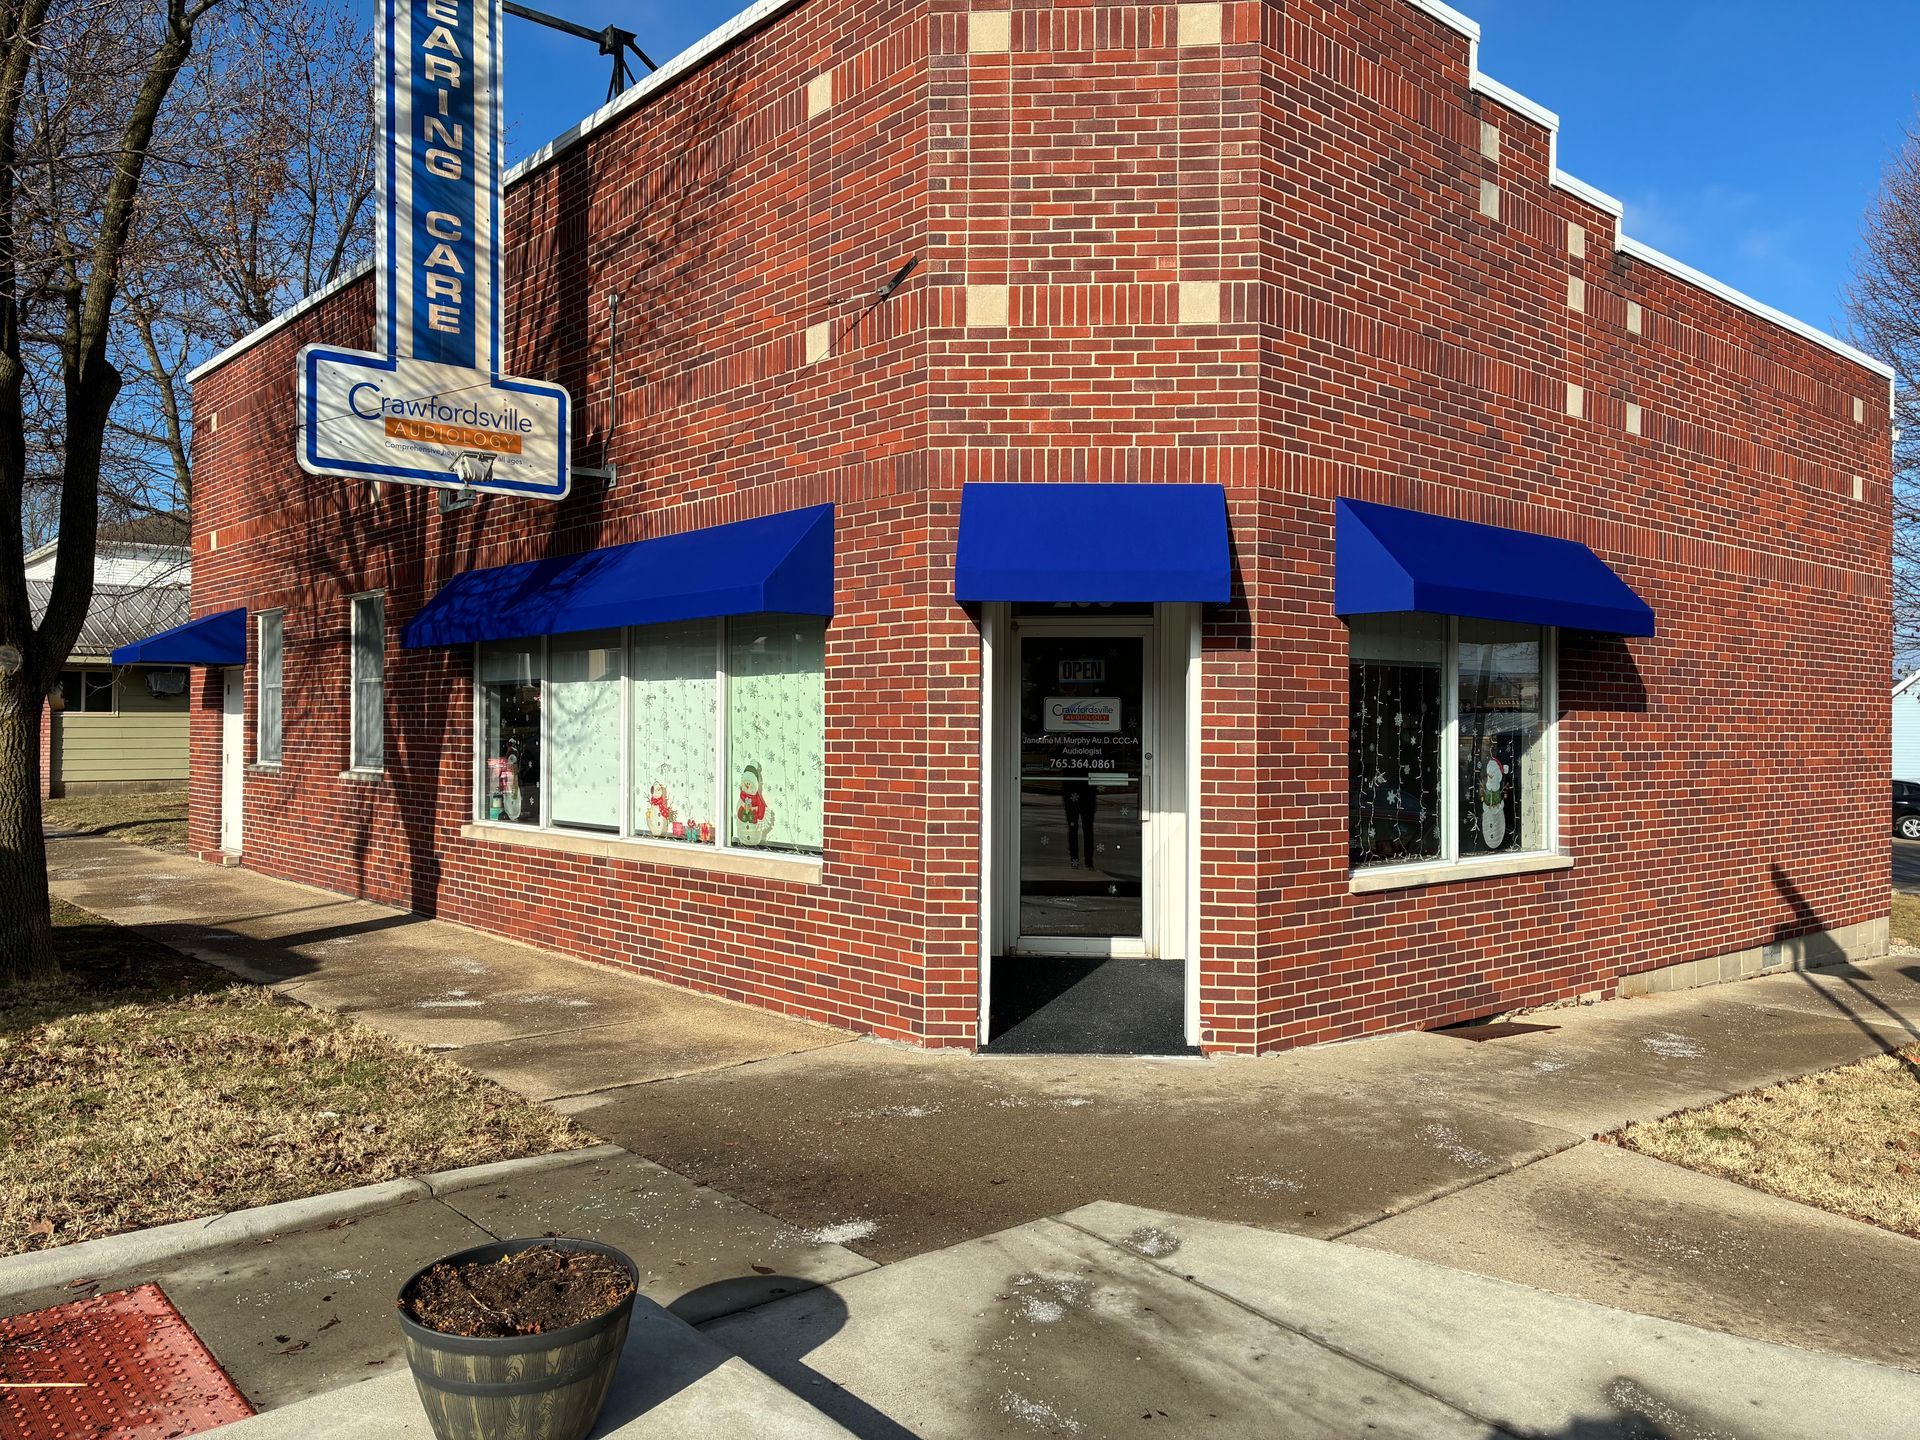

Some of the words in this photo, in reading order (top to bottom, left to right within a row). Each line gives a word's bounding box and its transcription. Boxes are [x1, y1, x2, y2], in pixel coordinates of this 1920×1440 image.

[424, 211, 465, 335] CARE
[348, 382, 532, 433] Crawfordsville
[394, 421, 515, 449] AUDIOLOGY
[1062, 661, 1100, 680] OPEN
[1052, 703, 1114, 717] Crawfordsville
[1112, 737, 1139, 745] CCC-A
[1062, 747, 1103, 756] Audiologist
[1050, 758, 1115, 769] 765.364.0861
